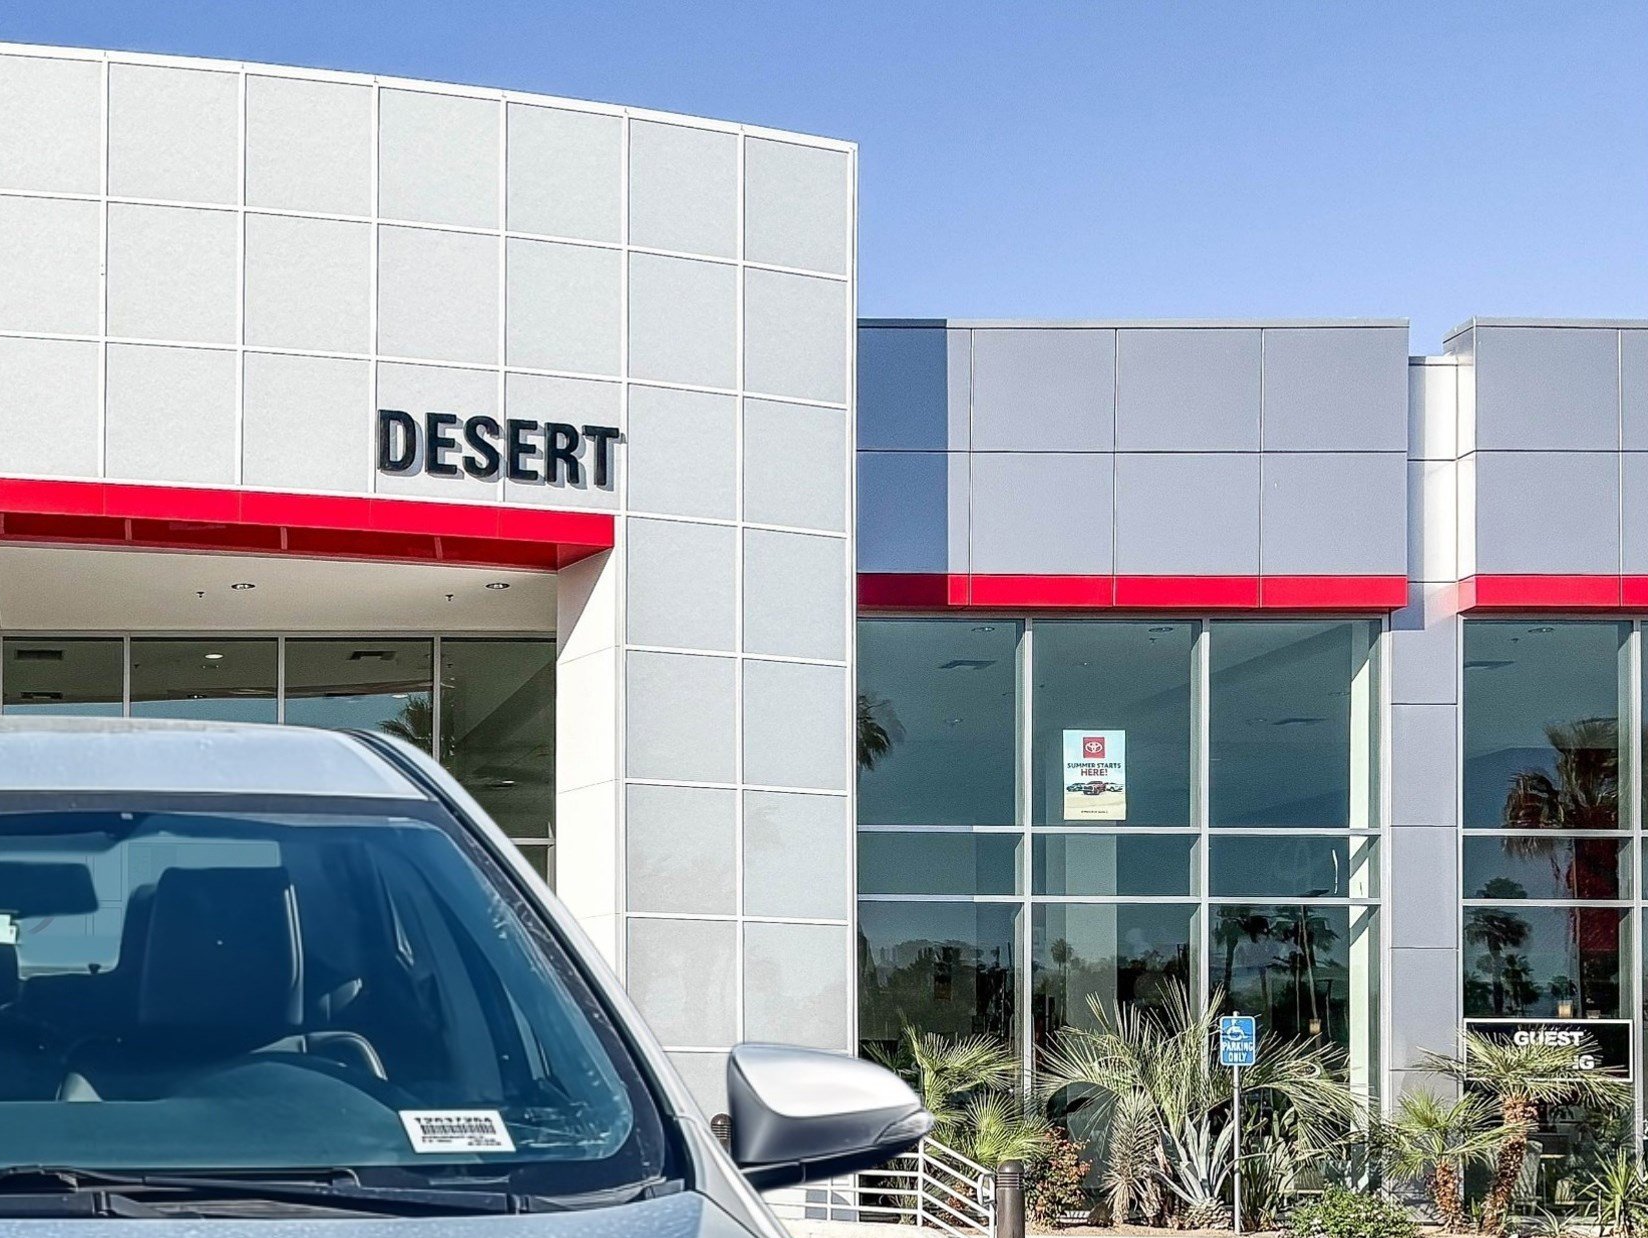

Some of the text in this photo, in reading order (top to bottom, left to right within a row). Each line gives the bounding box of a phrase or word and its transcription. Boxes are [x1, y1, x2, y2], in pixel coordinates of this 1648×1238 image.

[376, 408, 622, 487] DESERT
[1080, 768, 1108, 776] HERE!
[1513, 1030, 1584, 1047] GUEST
[1222, 1041, 1254, 1052] PARKING
[1228, 1051, 1247, 1063] ONLY
